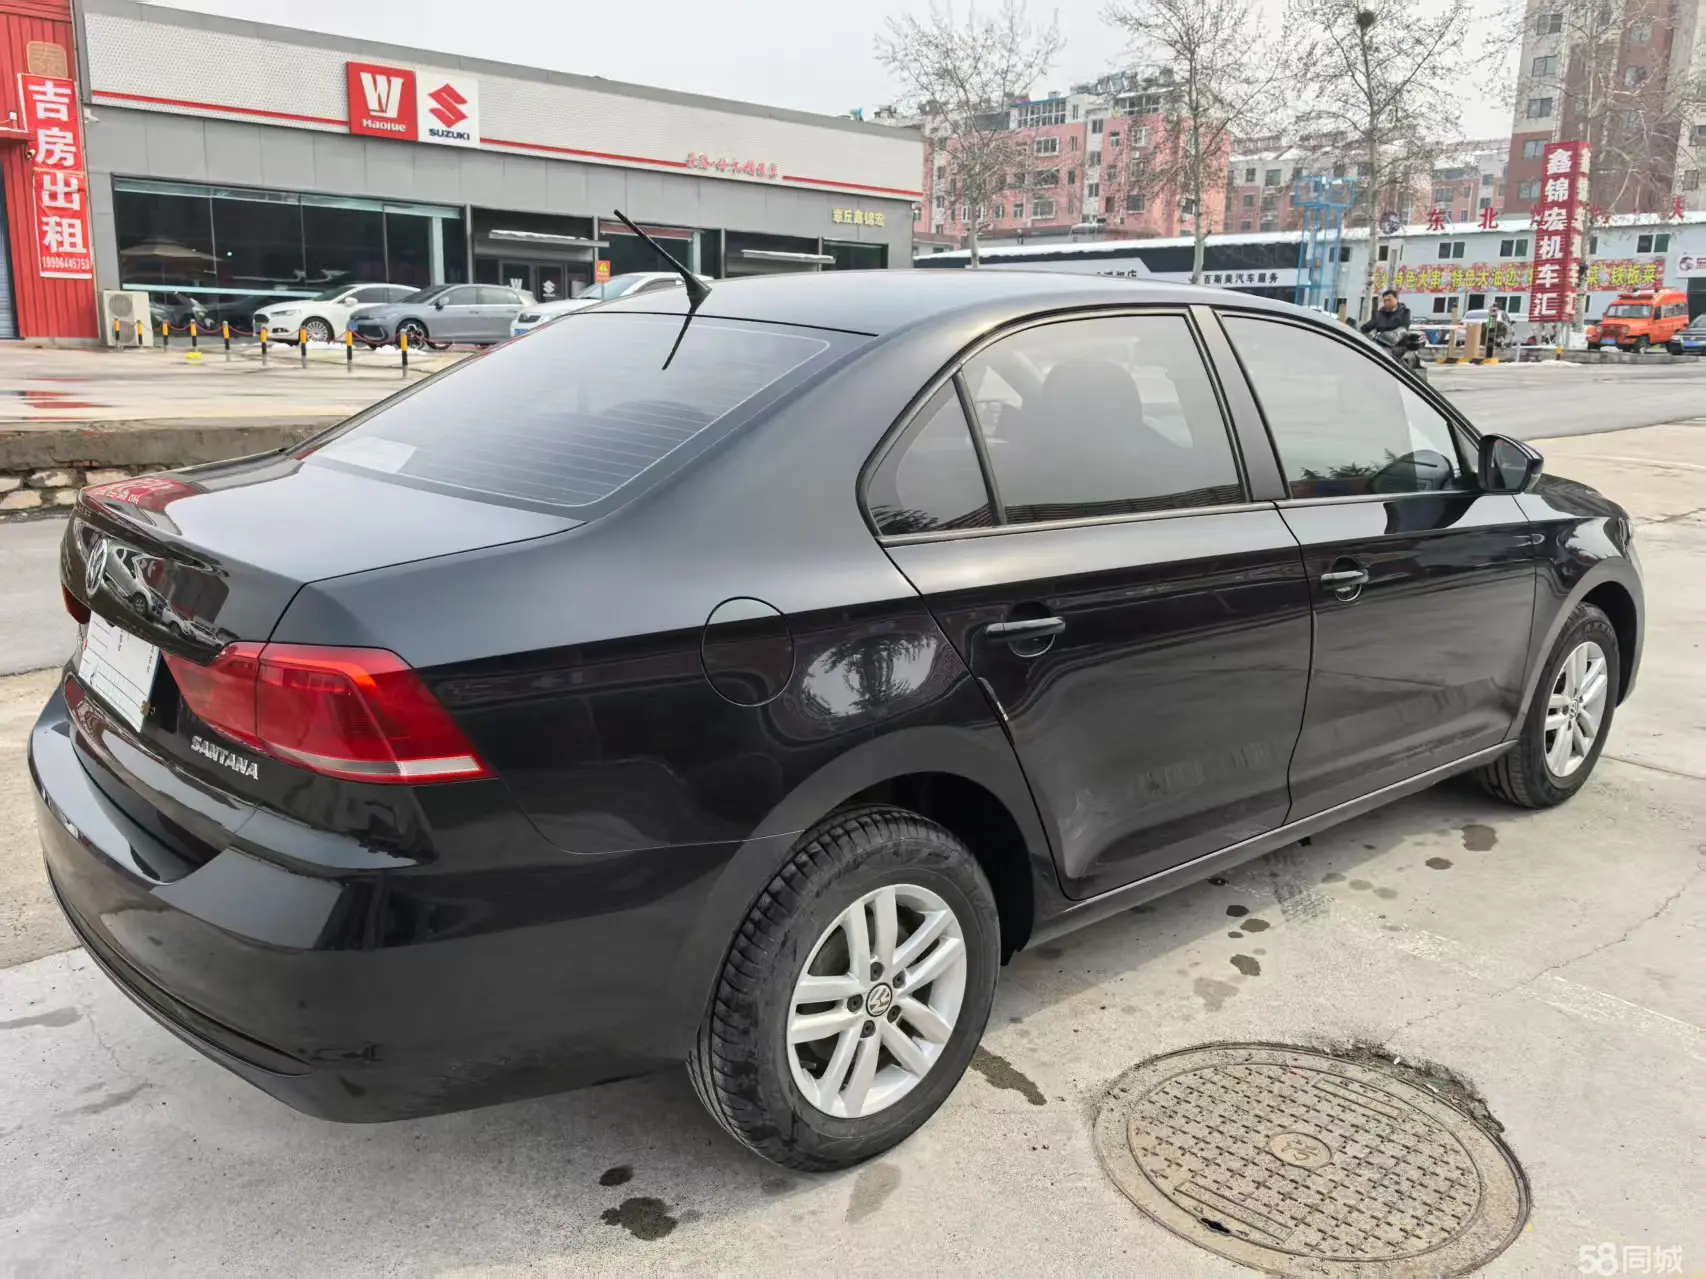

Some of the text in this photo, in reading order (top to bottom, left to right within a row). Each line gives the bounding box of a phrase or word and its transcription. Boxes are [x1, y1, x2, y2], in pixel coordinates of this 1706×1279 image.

[362, 119, 407, 132] Haojue
[428, 128, 470, 140] SUZUKI
[28, 80, 86, 254] 吉房出租
[1533, 148, 1572, 316] 鑫锦宏机车汇
[191, 735, 259, 780] SANTANA
